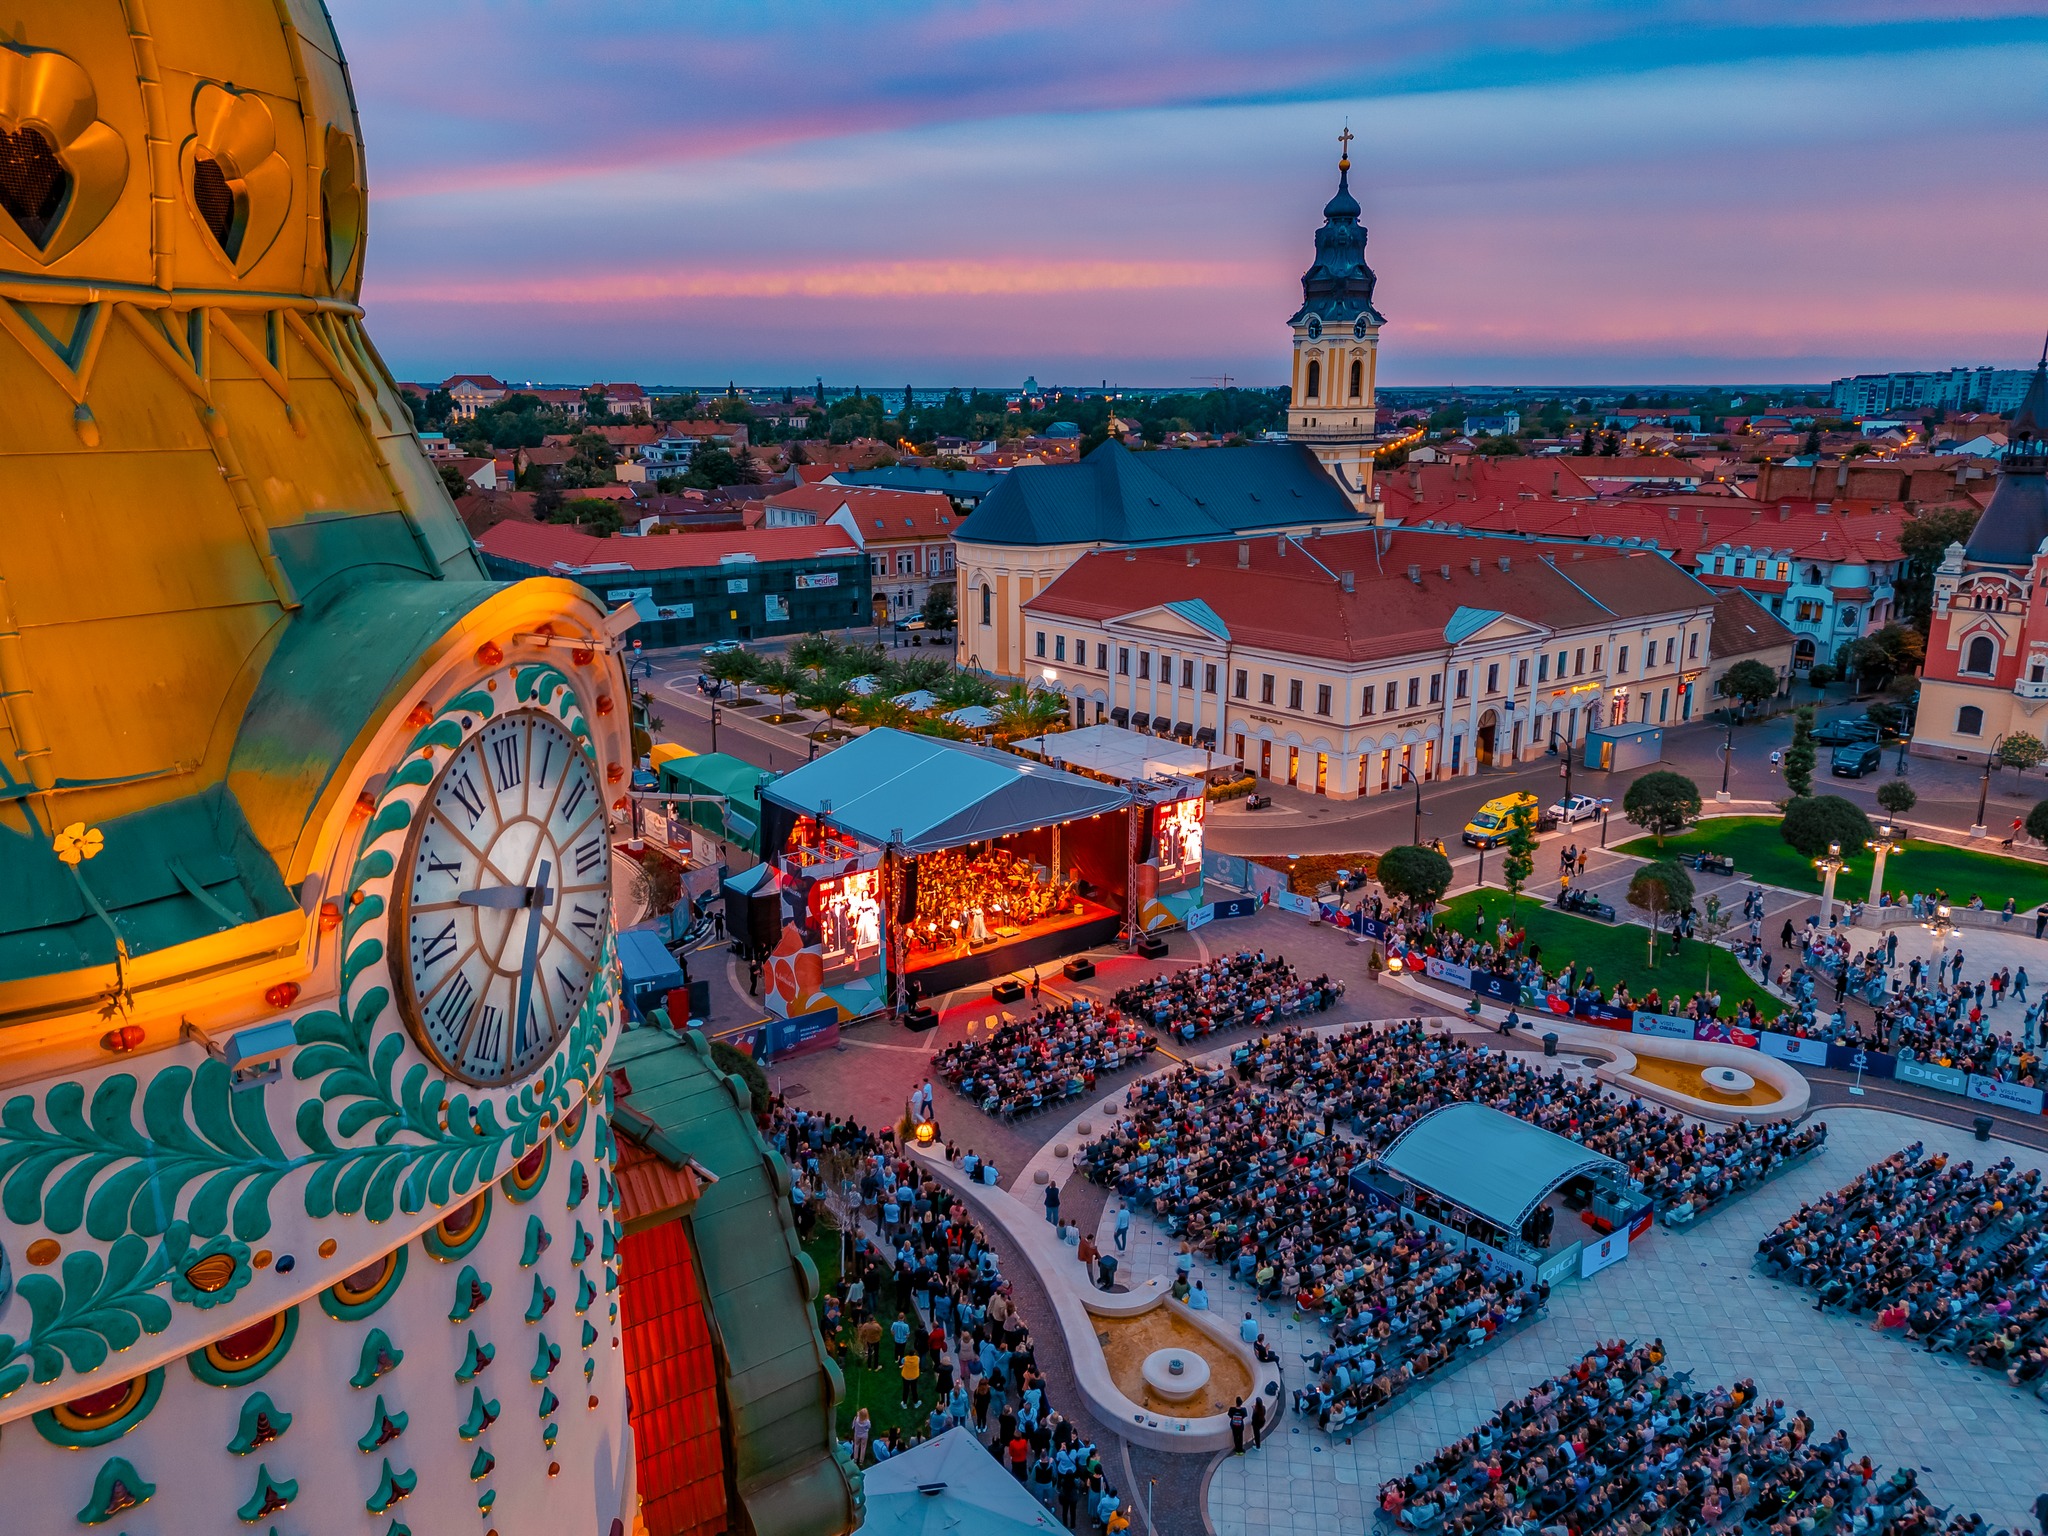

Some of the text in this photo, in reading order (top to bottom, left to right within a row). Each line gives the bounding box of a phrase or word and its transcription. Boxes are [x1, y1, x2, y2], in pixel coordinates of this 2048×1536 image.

[493, 734, 522, 794] XII
[538, 740, 553, 790] I
[452, 769, 487, 830] XI
[561, 776, 587, 822] II
[427, 851, 462, 883] X
[575, 836, 601, 877] III
[422, 918, 458, 970] IX
[572, 904, 598, 940] IV
[555, 966, 576, 1002] V
[436, 969, 478, 1047] VIII
[474, 1004, 503, 1062] VII
[1904, 1065, 1960, 1087] DIGI
[1542, 1252, 1577, 1281] DIGI
